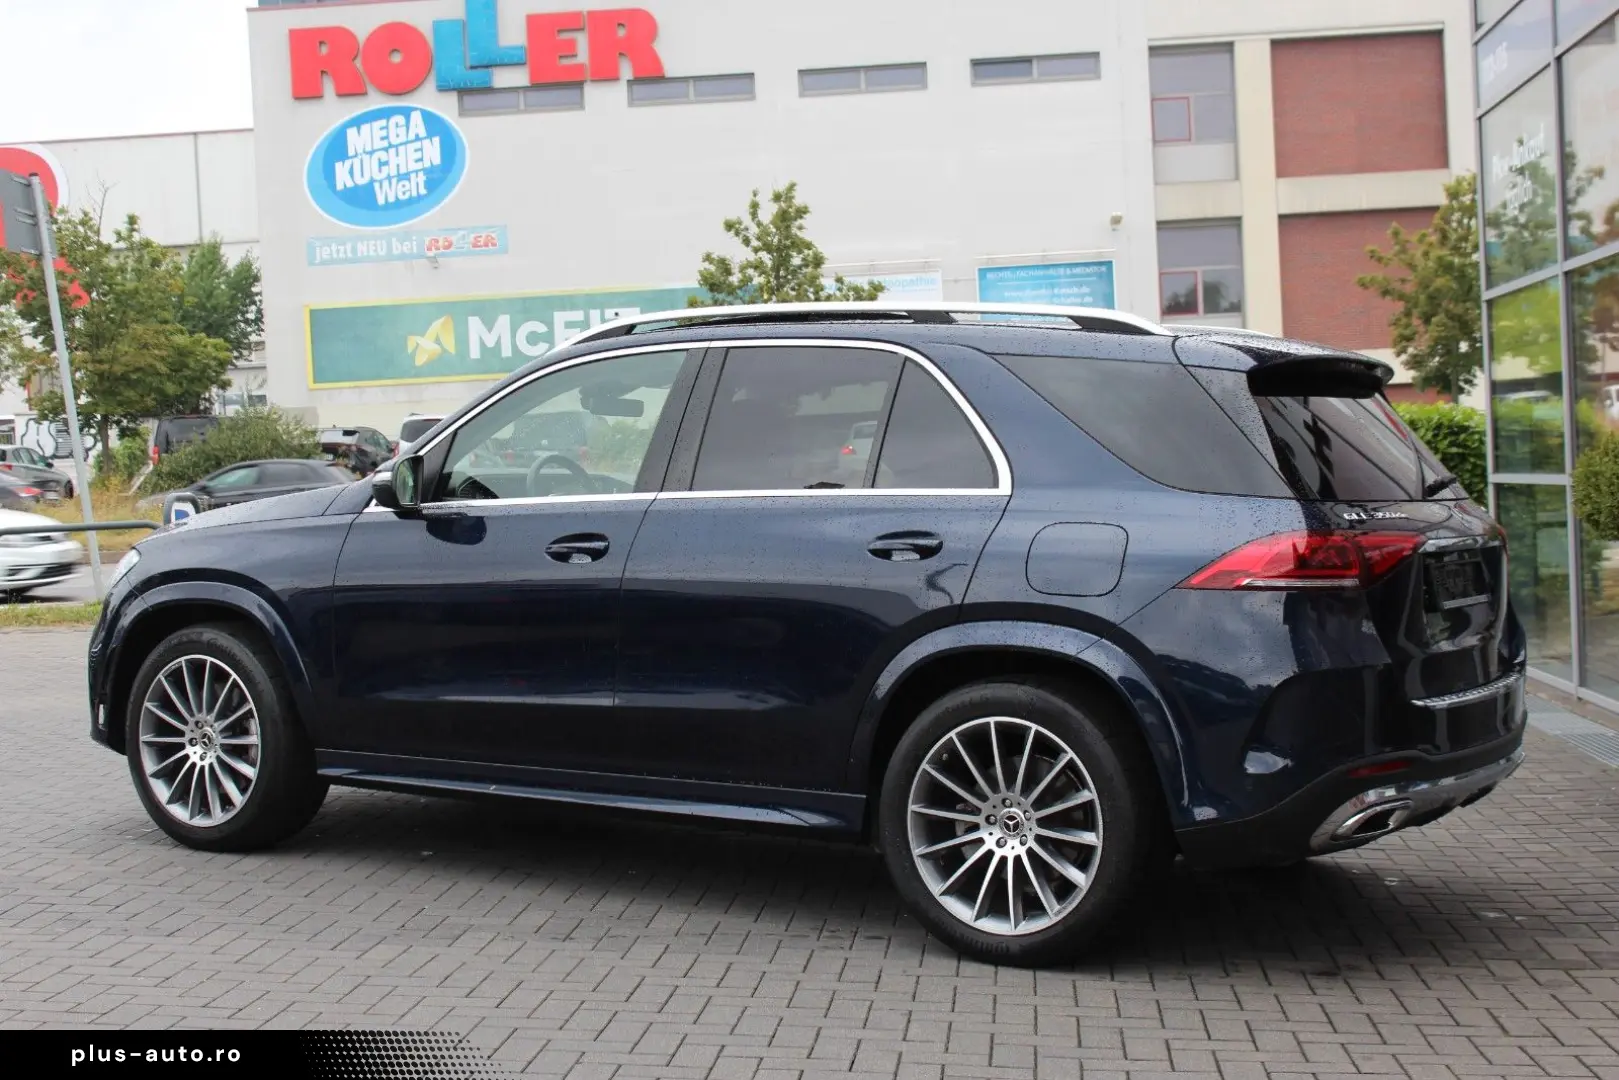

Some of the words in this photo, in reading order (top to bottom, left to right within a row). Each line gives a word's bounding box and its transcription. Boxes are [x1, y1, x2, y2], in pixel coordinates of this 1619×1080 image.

[288, 0, 666, 99] ROLLER
[346, 110, 428, 158] MEGA
[334, 136, 442, 191] KÜCHEN
[373, 170, 428, 206] Welt
[314, 240, 352, 263] jetzt
[357, 239, 388, 257] NEU
[391, 235, 418, 255] bei
